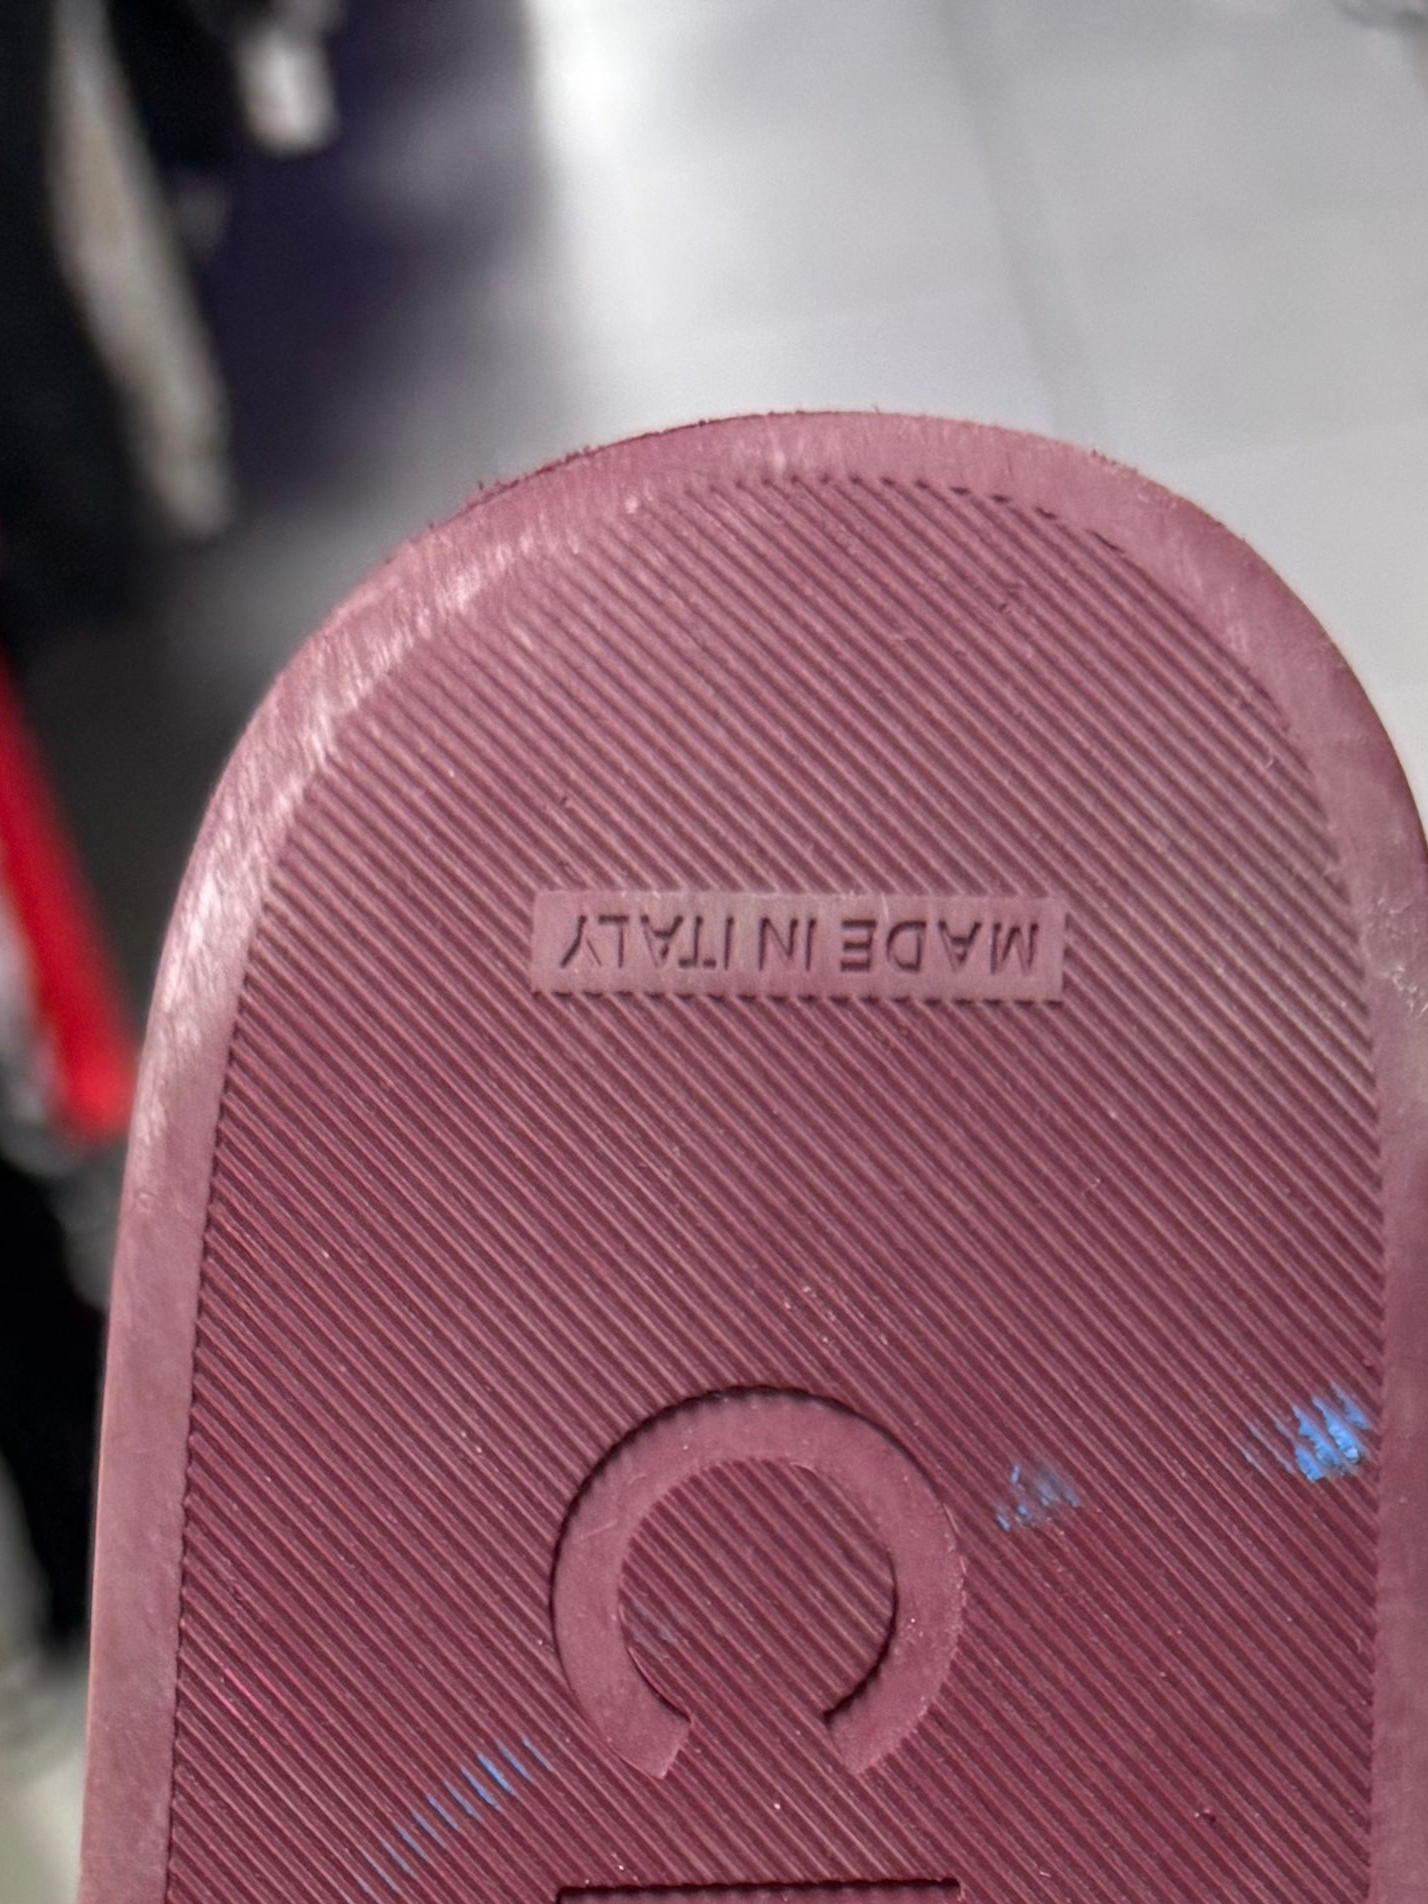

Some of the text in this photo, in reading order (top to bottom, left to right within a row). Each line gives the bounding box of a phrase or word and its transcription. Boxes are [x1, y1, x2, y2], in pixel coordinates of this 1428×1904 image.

[559, 913, 1040, 976] MADE IN ITALY
